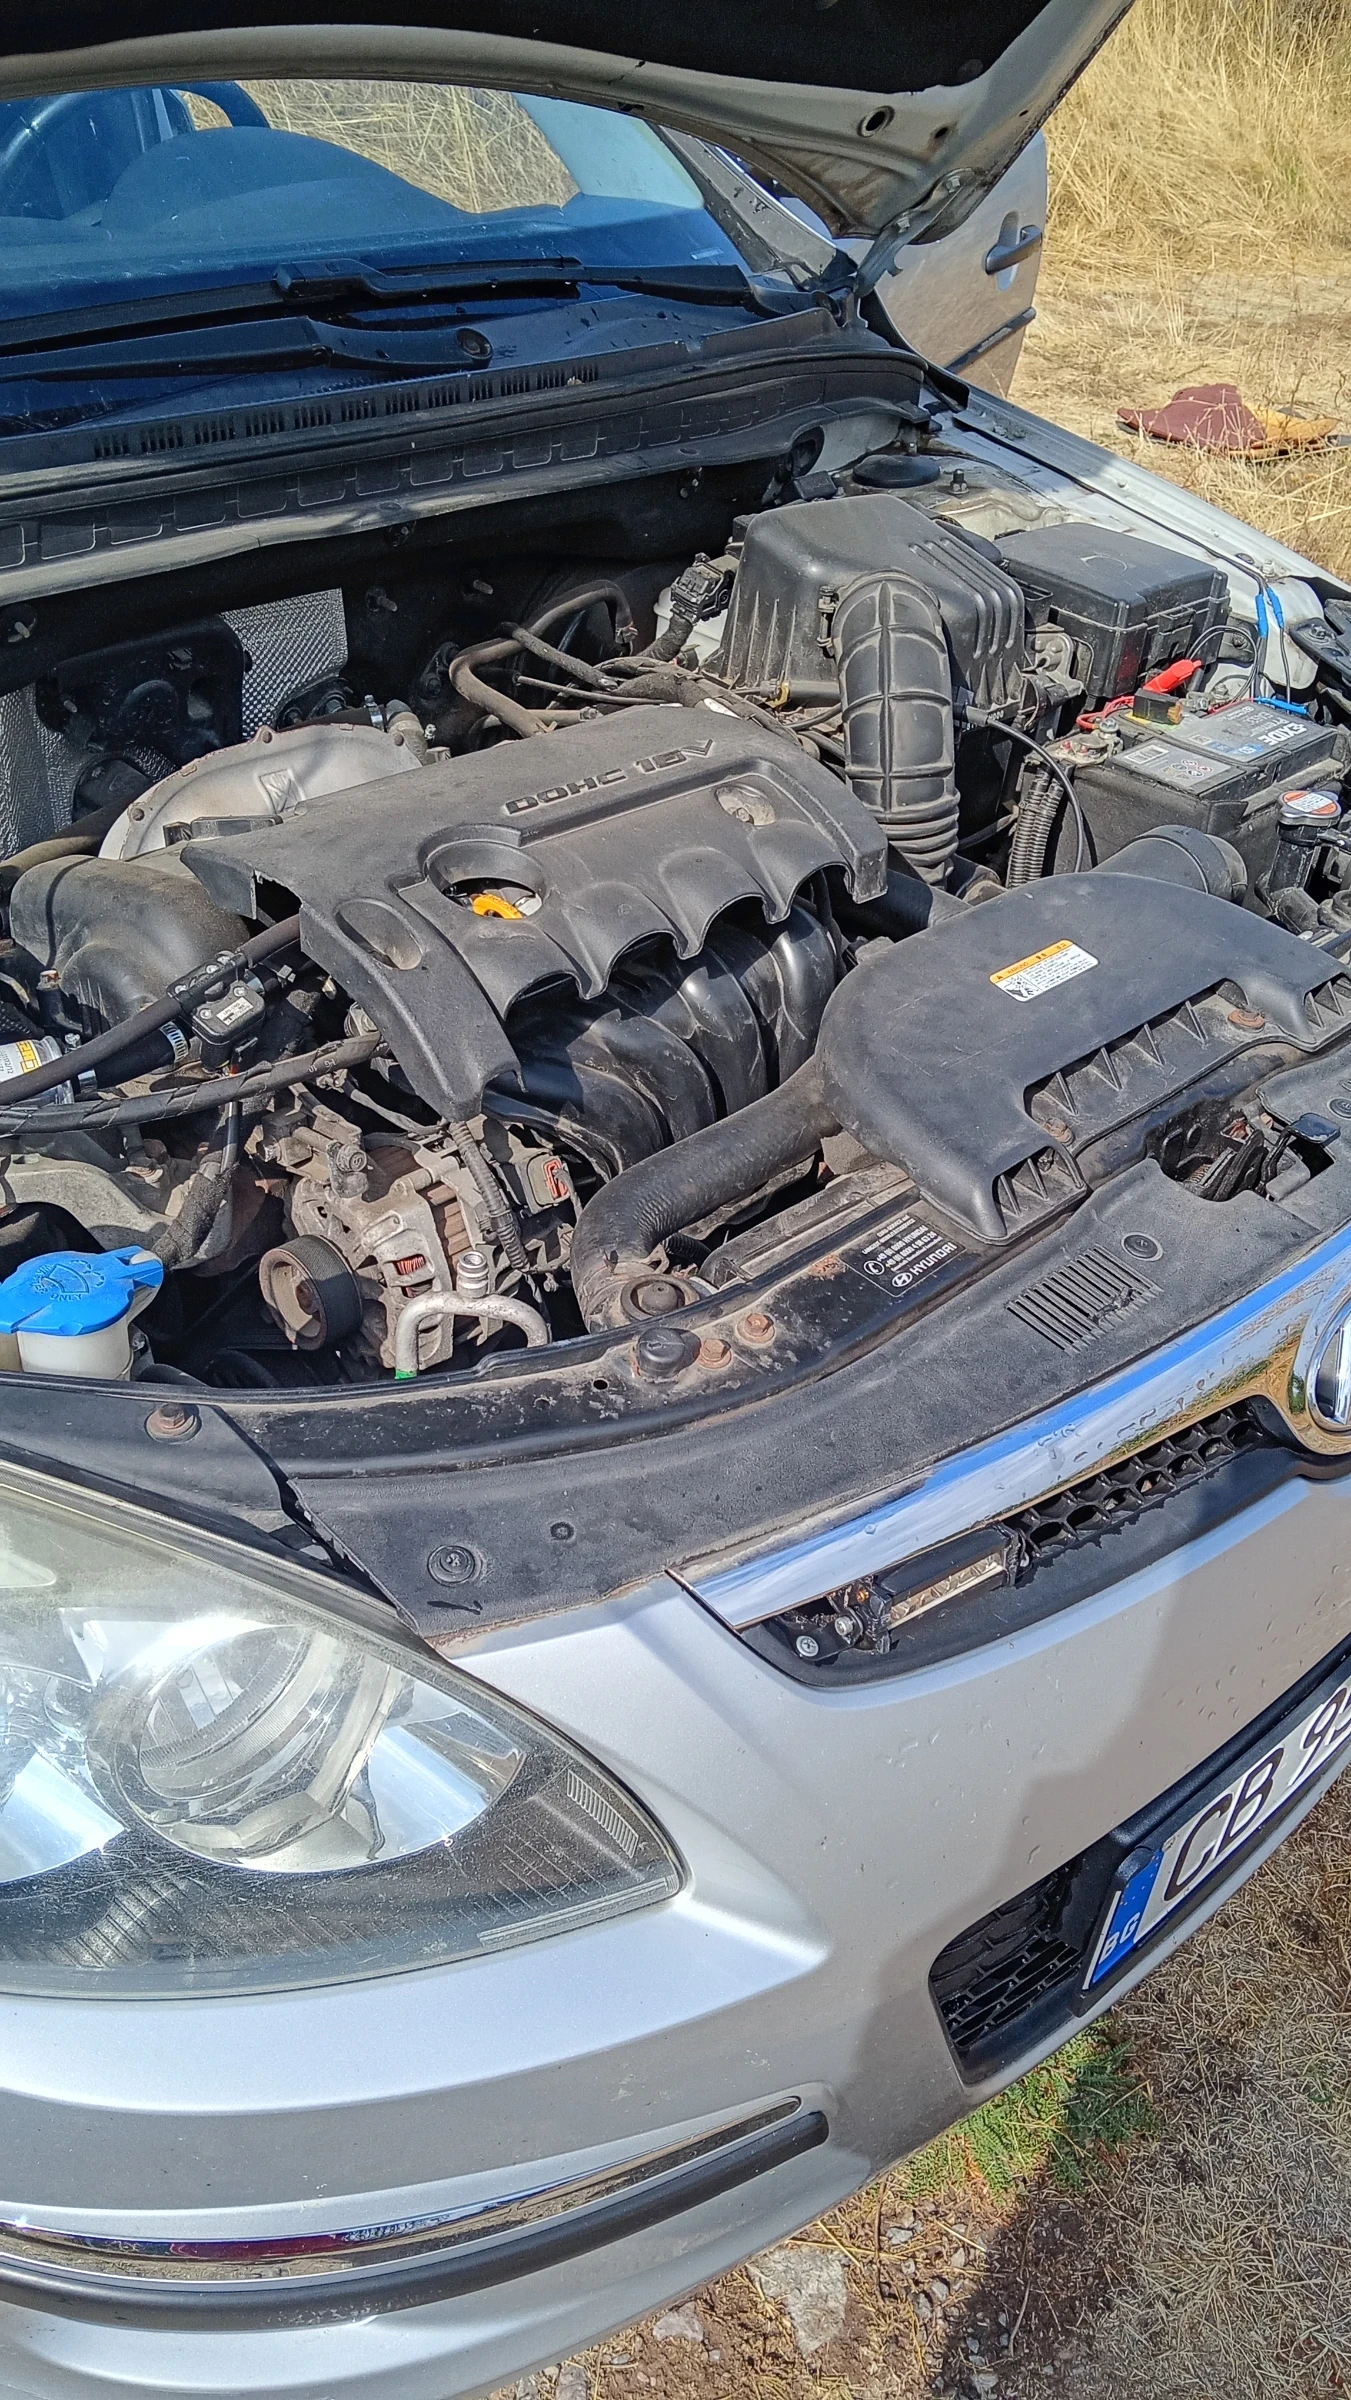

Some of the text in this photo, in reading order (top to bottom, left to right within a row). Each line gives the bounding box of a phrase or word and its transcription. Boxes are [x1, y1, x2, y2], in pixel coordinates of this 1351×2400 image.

[1258, 723, 1307, 746] EXIDE
[503, 738, 714, 815] DOHC 16V
[902, 1225, 928, 1243] HYUNDAI
[909, 1241, 958, 1276] HYUNDAI
[1162, 1747, 1285, 1901] CB
[1098, 1912, 1141, 1965] BG
